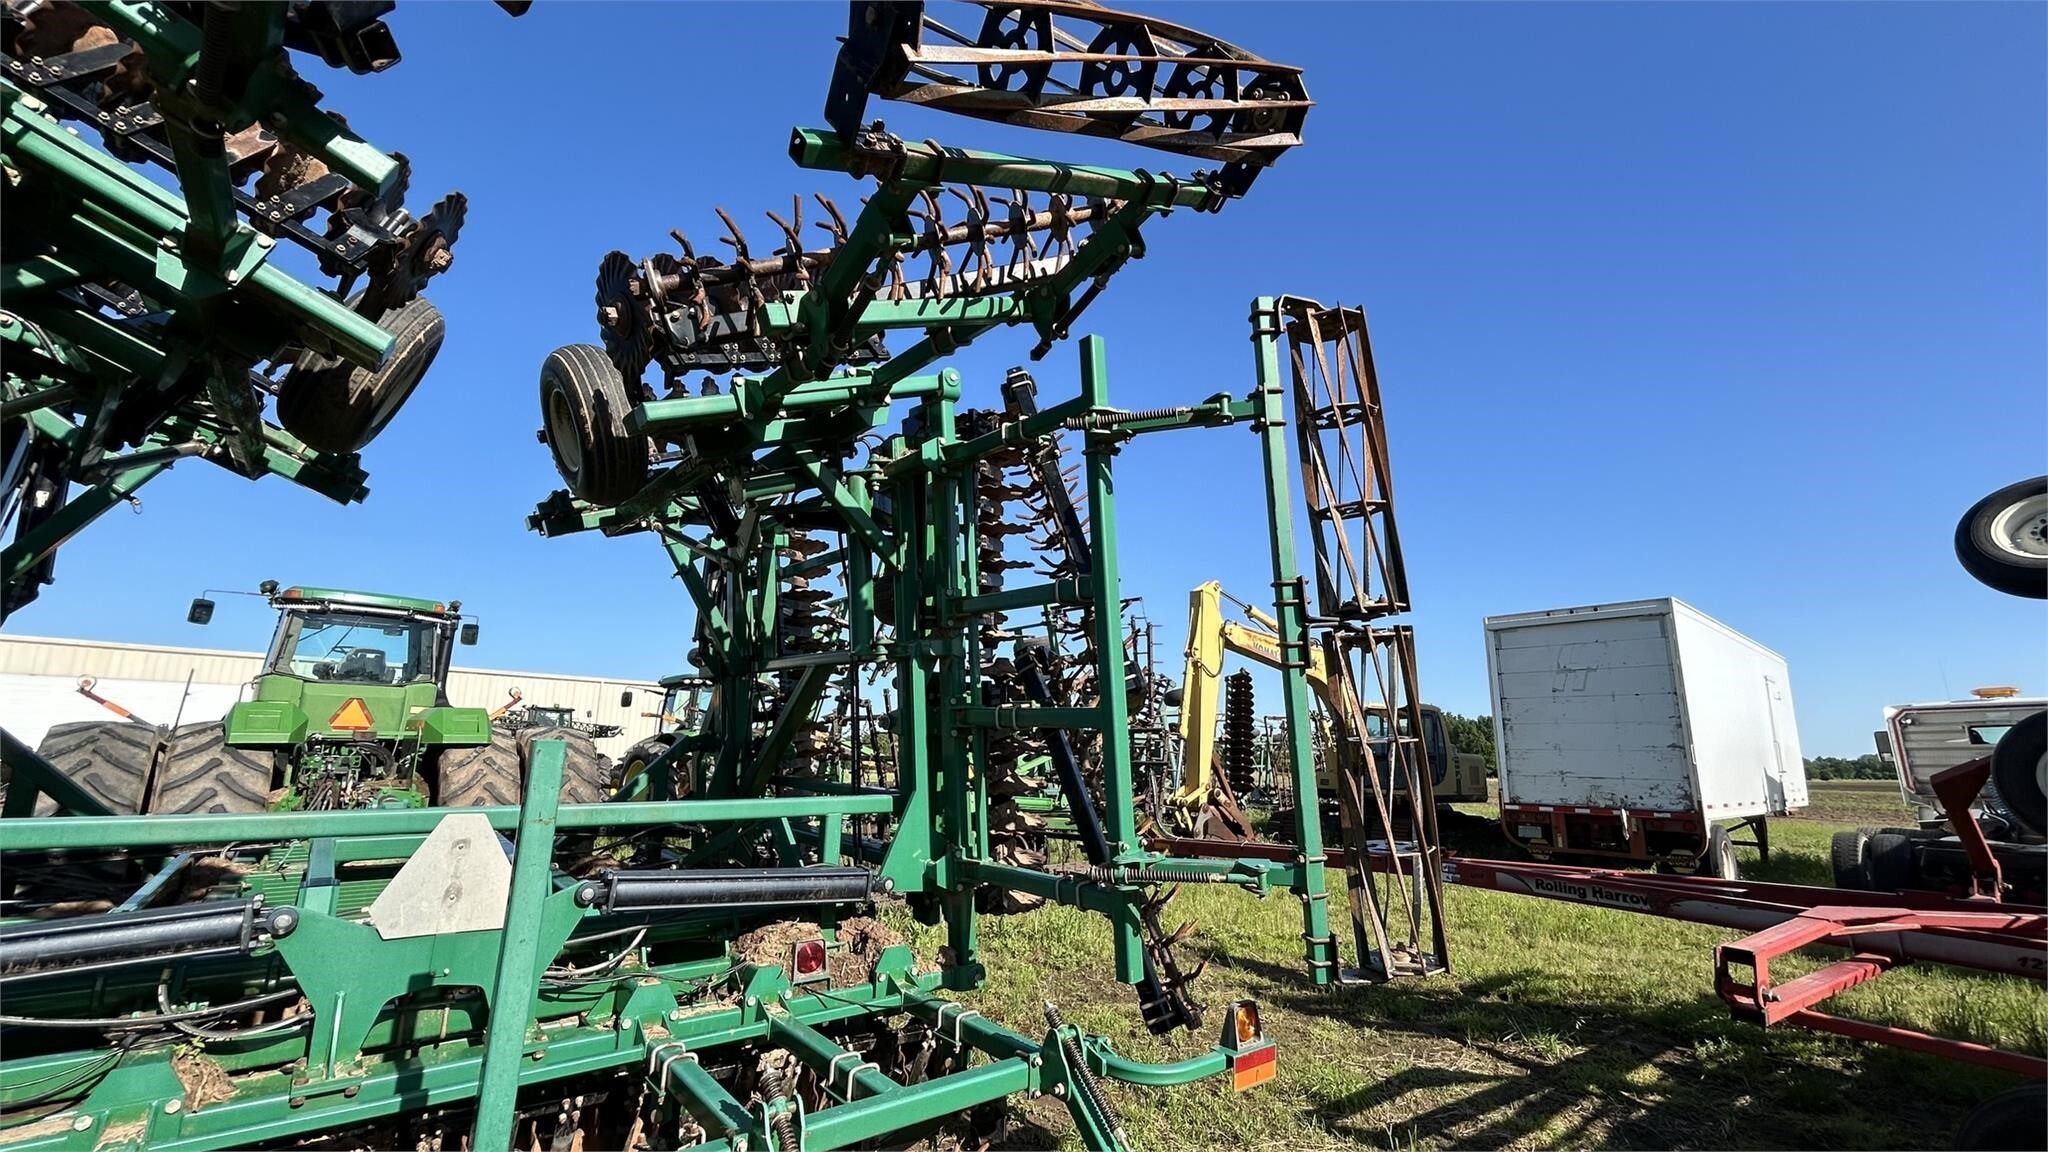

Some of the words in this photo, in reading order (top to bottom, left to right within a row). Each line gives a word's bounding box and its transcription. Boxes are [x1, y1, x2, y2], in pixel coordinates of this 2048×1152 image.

[1253, 641, 1280, 657] KOMAT
[1535, 879, 1587, 898] Rolling
[2017, 956, 2048, 970] 12
